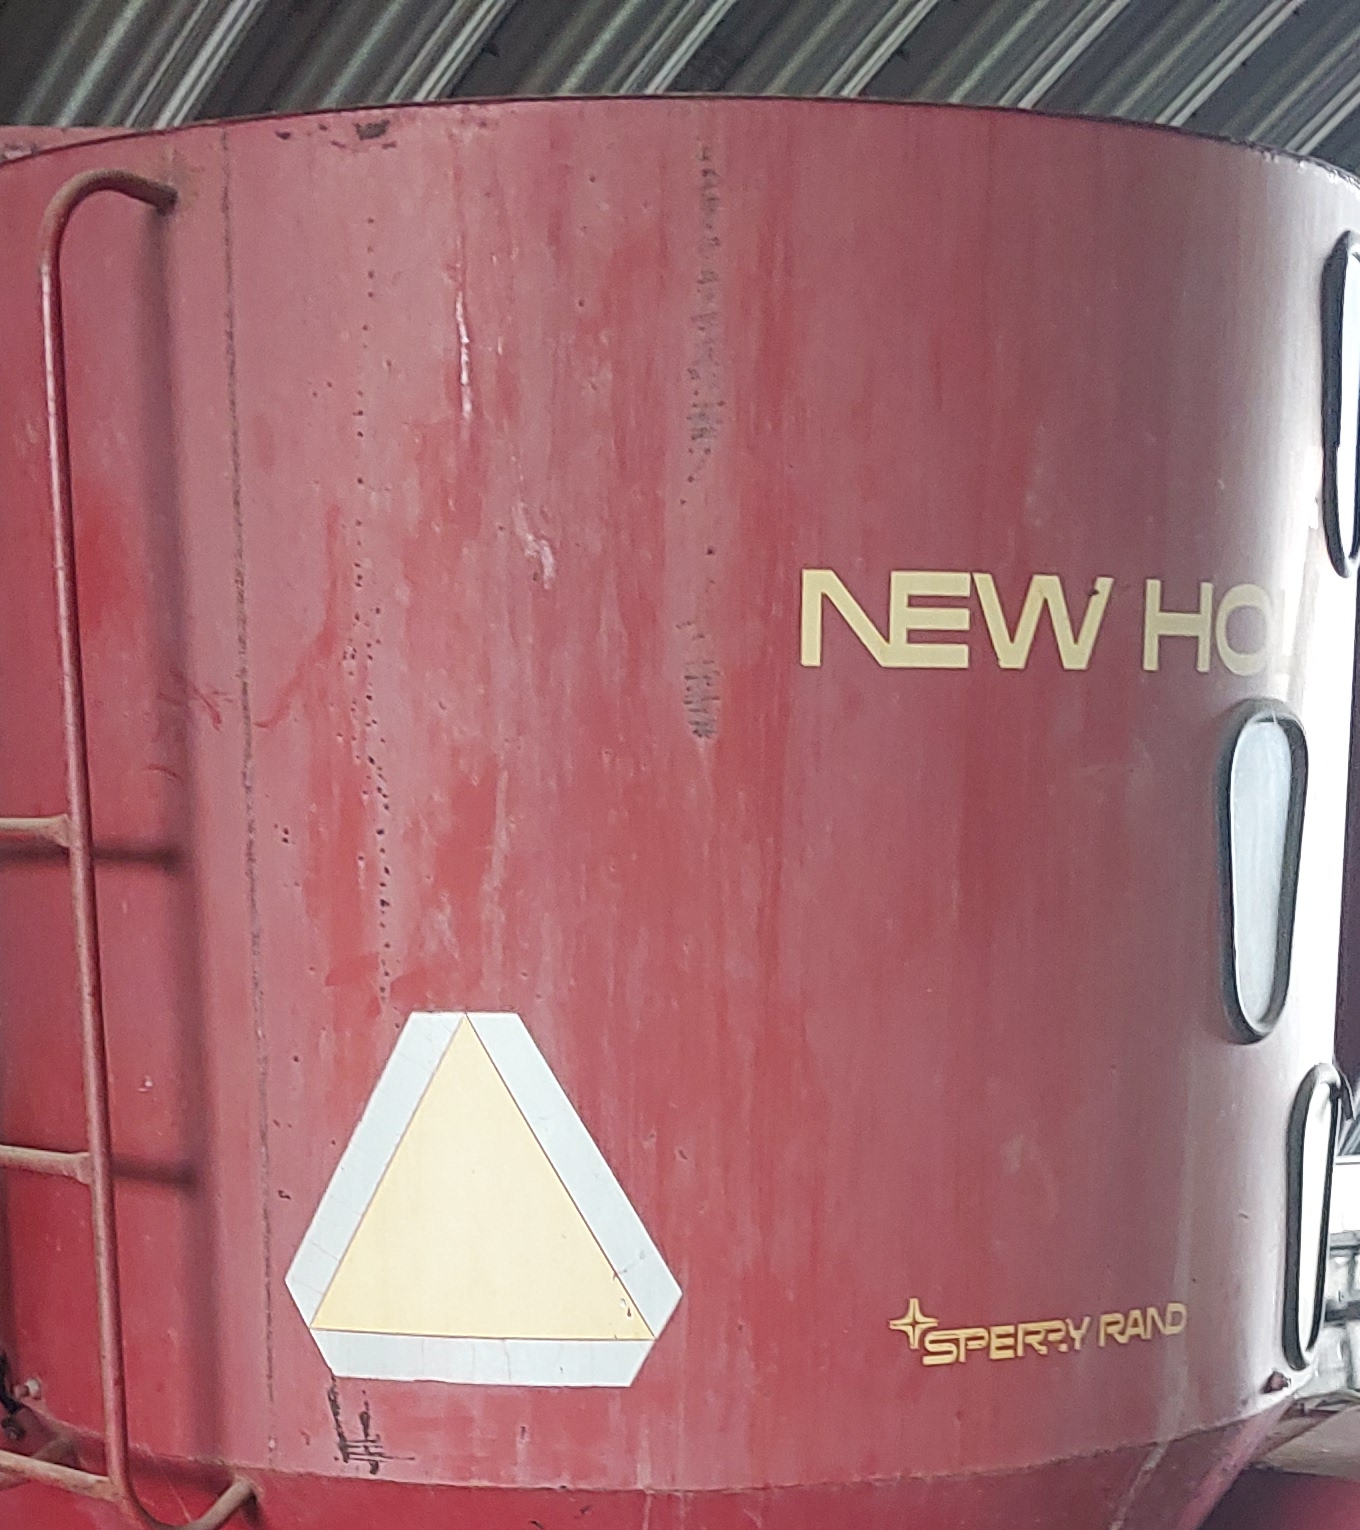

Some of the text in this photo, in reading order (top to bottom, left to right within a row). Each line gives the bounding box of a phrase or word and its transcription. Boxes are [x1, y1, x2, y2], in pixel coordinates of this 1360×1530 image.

[800, 568, 1114, 670] NEW
[922, 1303, 1187, 1366] SPERRY RAND
